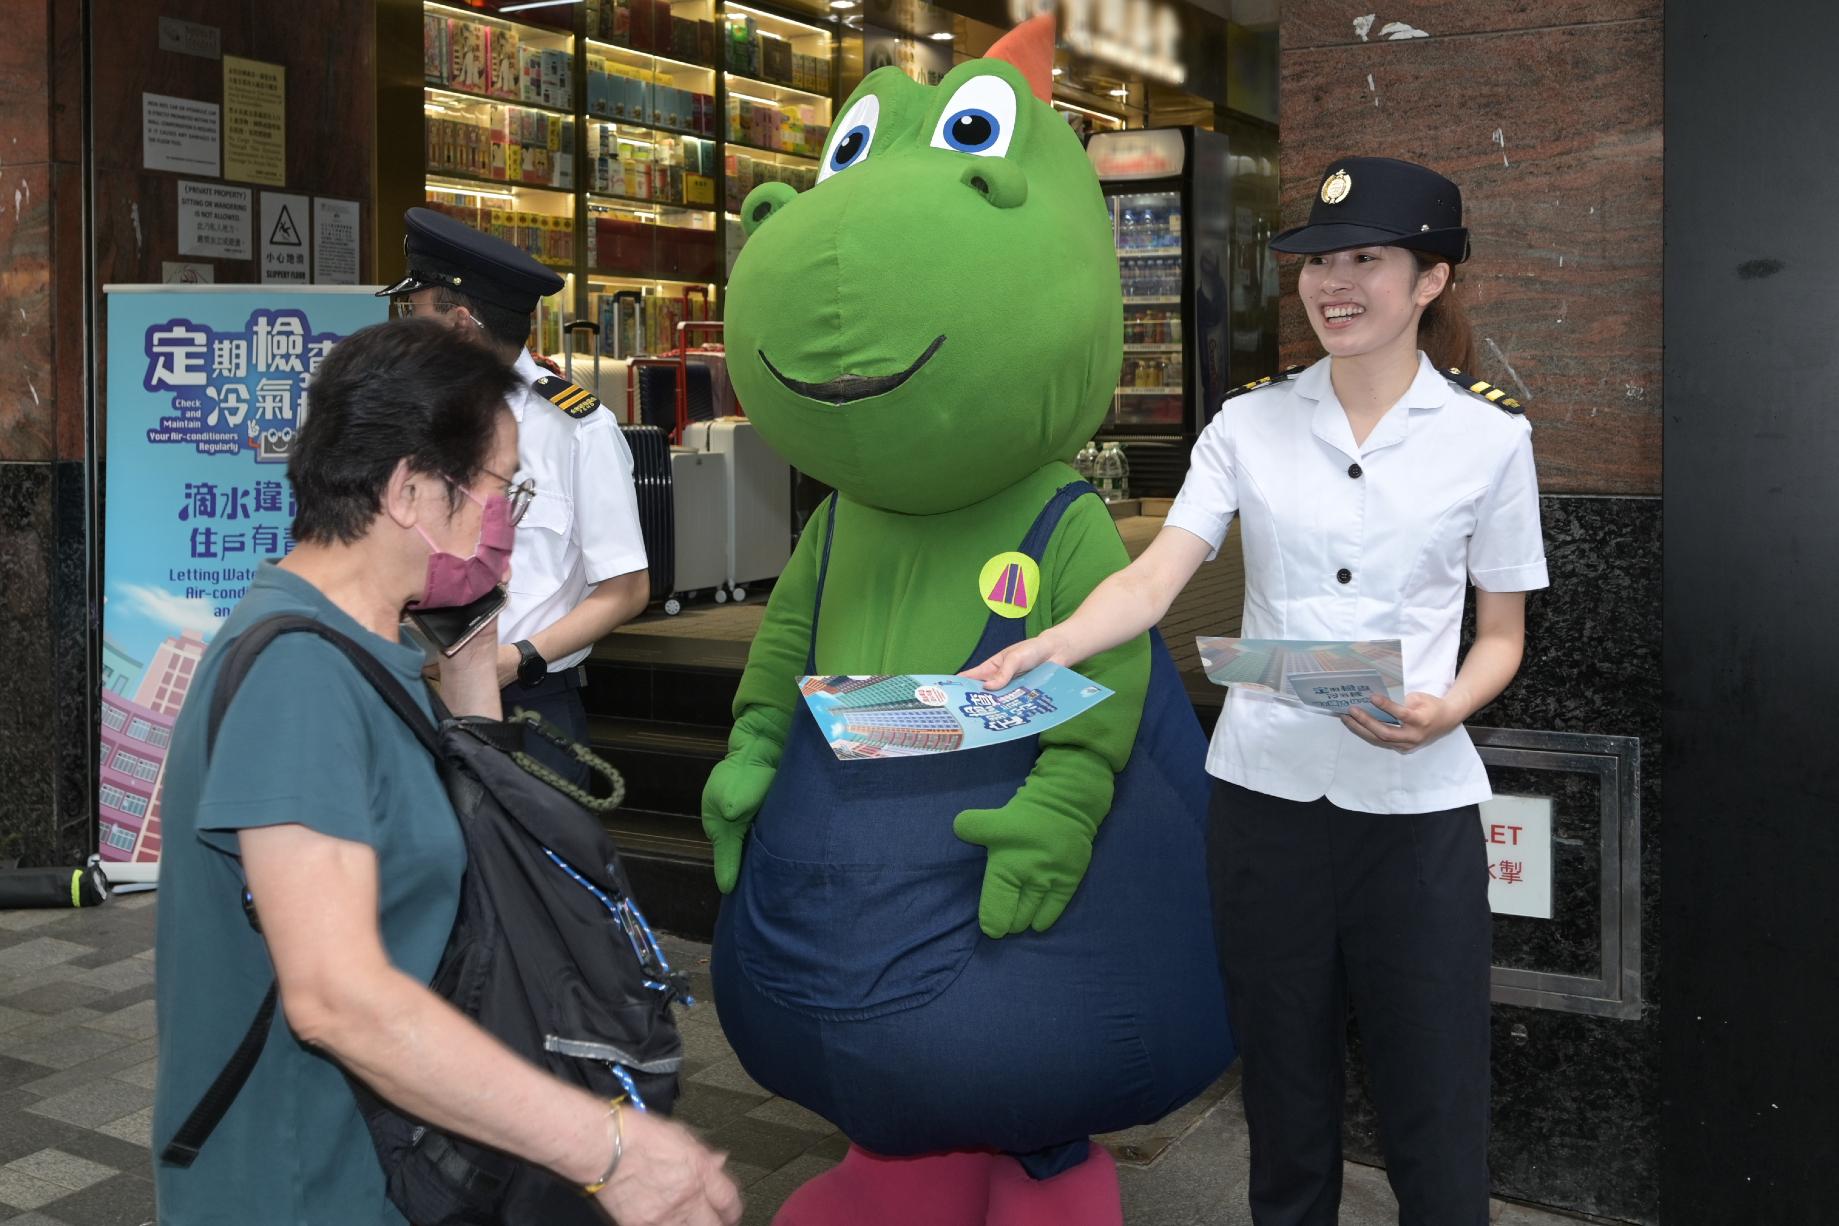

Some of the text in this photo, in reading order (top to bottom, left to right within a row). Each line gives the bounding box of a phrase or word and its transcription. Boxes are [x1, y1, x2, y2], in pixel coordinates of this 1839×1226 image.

[266, 252, 304, 265] 小心地滑
[175, 399, 202, 408] Check
[186, 409, 202, 418] and
[163, 419, 202, 429] Maintain
[149, 431, 239, 441] Your Air-conditioners
[199, 442, 239, 453] Regularly
[178, 480, 297, 522] 滴水違
[169, 568, 220, 585] Letting
[1484, 824, 1523, 846] ET
